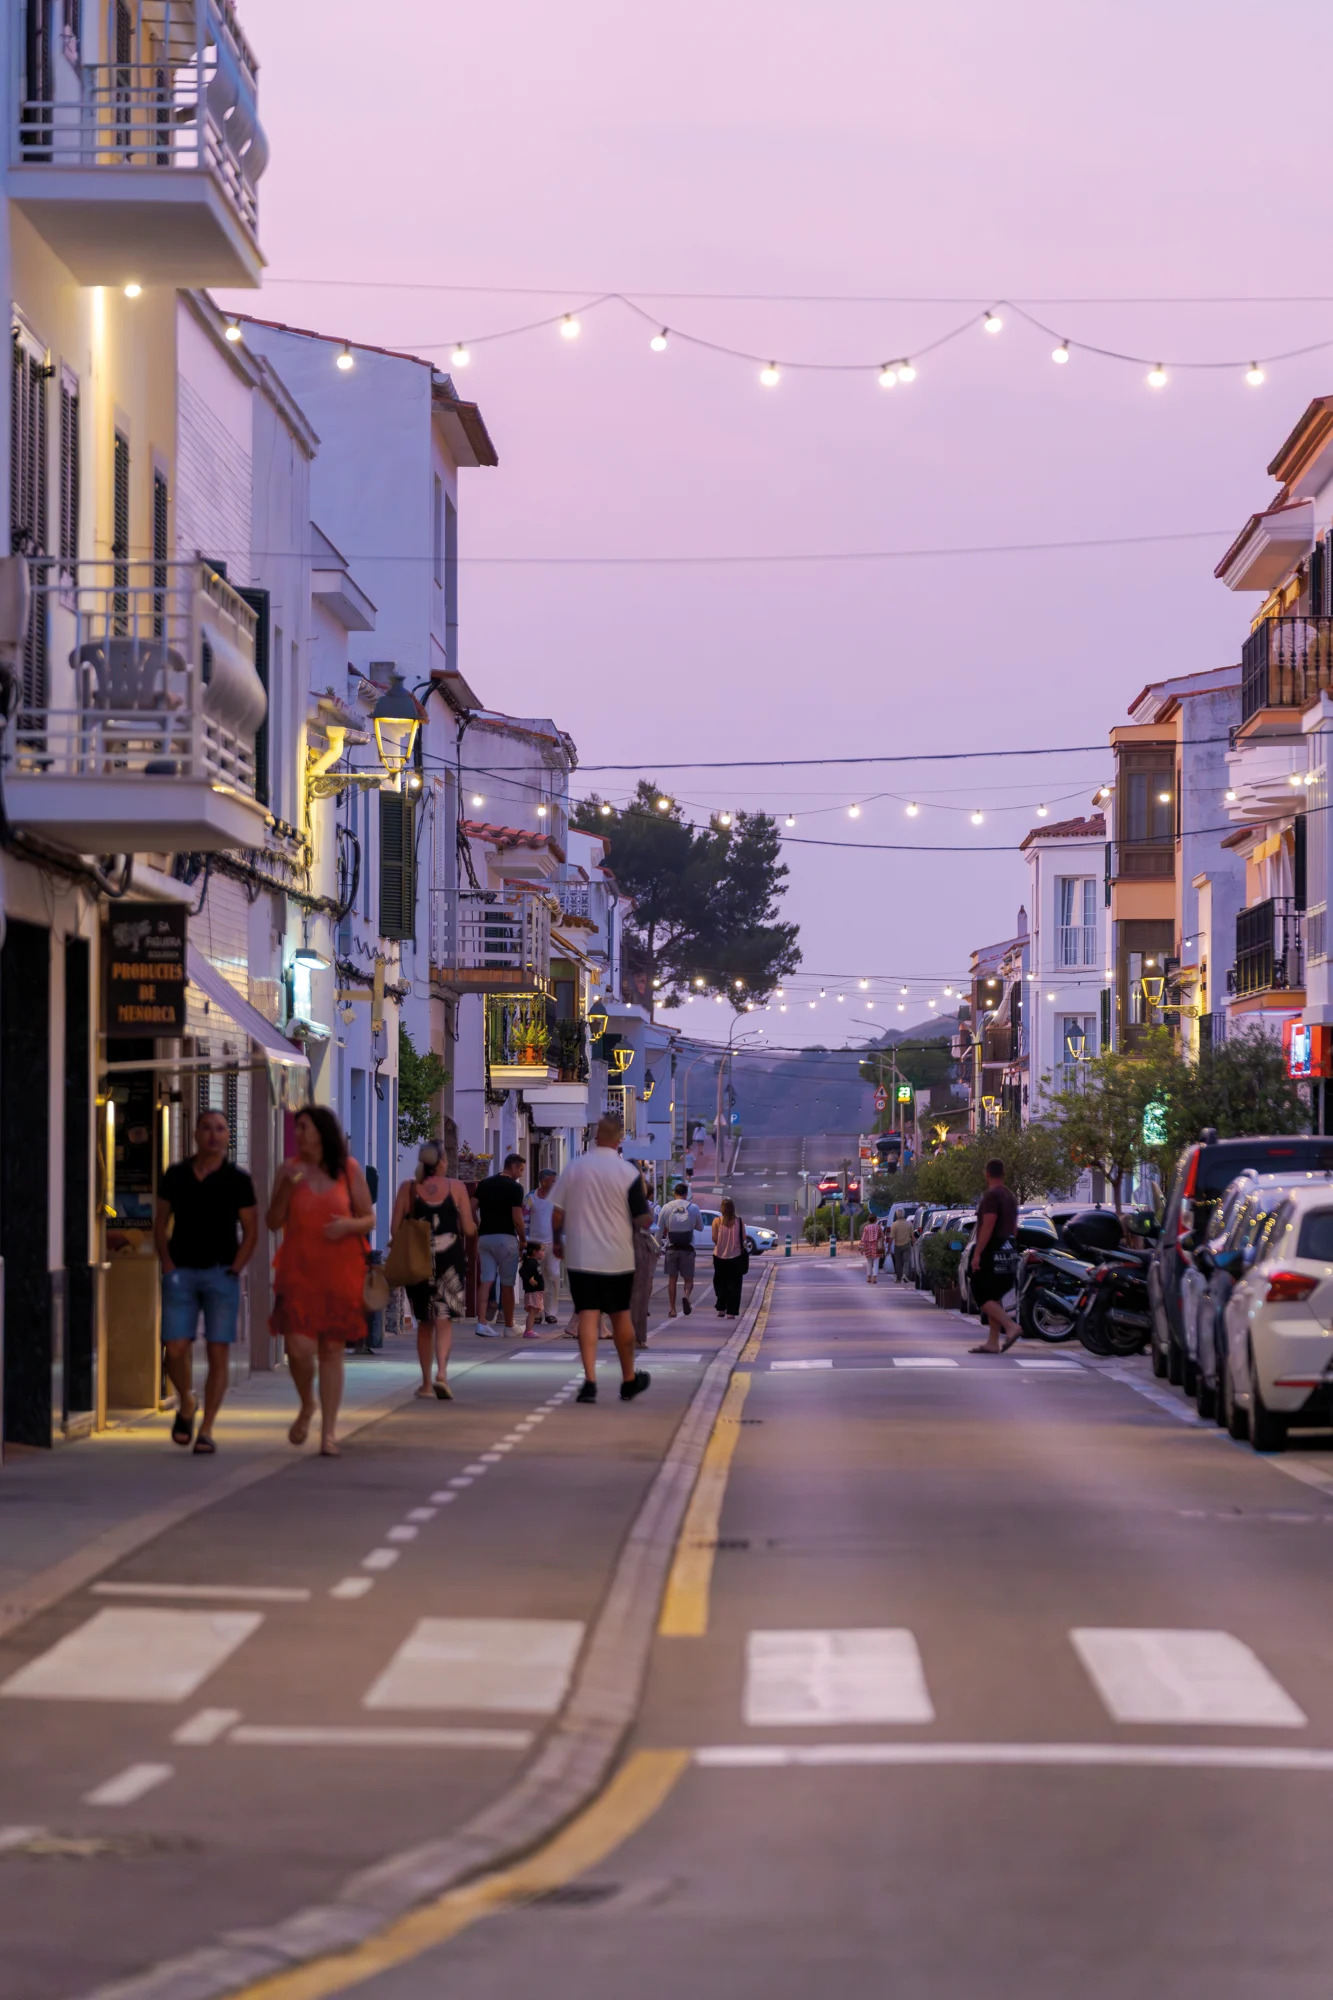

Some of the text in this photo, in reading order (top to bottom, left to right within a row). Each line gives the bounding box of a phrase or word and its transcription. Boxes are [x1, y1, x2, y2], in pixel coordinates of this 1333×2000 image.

[157, 920, 171, 932] SA
[112, 962, 183, 979] PRODUCTES
[138, 984, 156, 1000] DE
[118, 1004, 176, 1022] MENORCA
[730, 1113, 738, 1123] P
